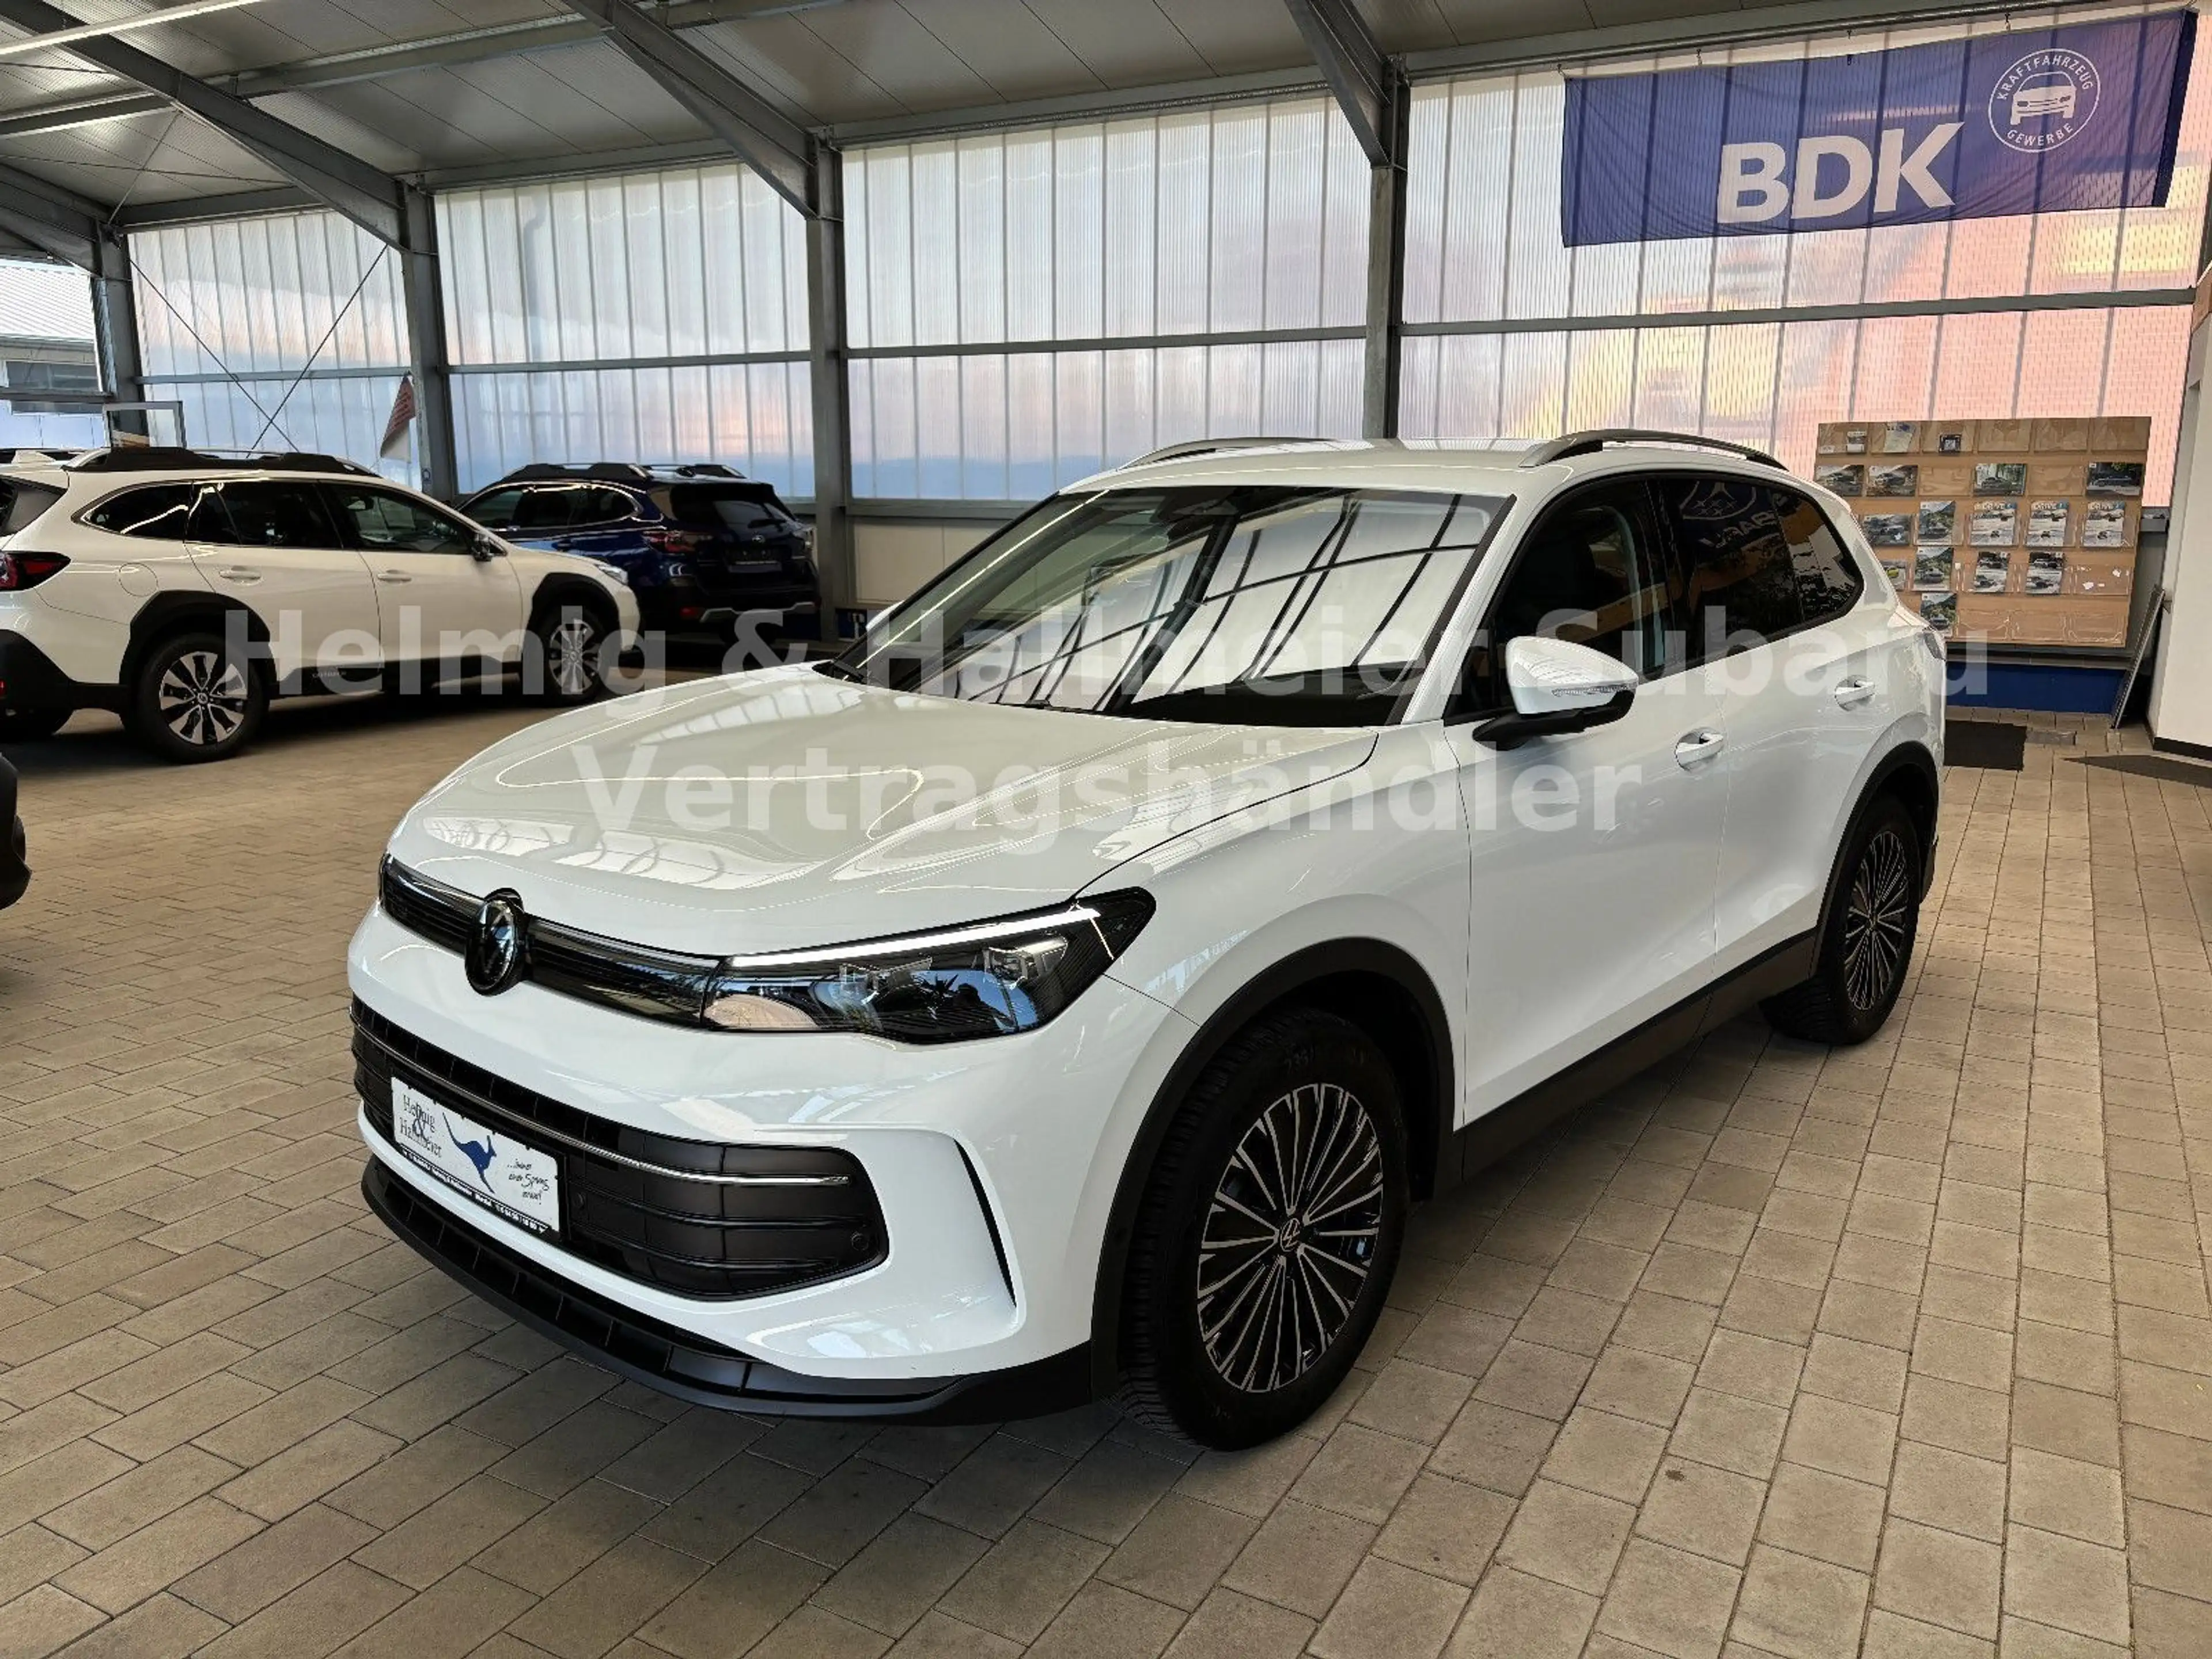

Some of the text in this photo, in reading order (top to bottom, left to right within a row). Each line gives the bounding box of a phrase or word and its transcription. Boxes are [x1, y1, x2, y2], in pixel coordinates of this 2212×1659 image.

[1997, 55, 2093, 100] KRAFTFAHRZEUG
[2007, 123, 2073, 145] GEWERBE
[1717, 122, 1965, 224] BDK
